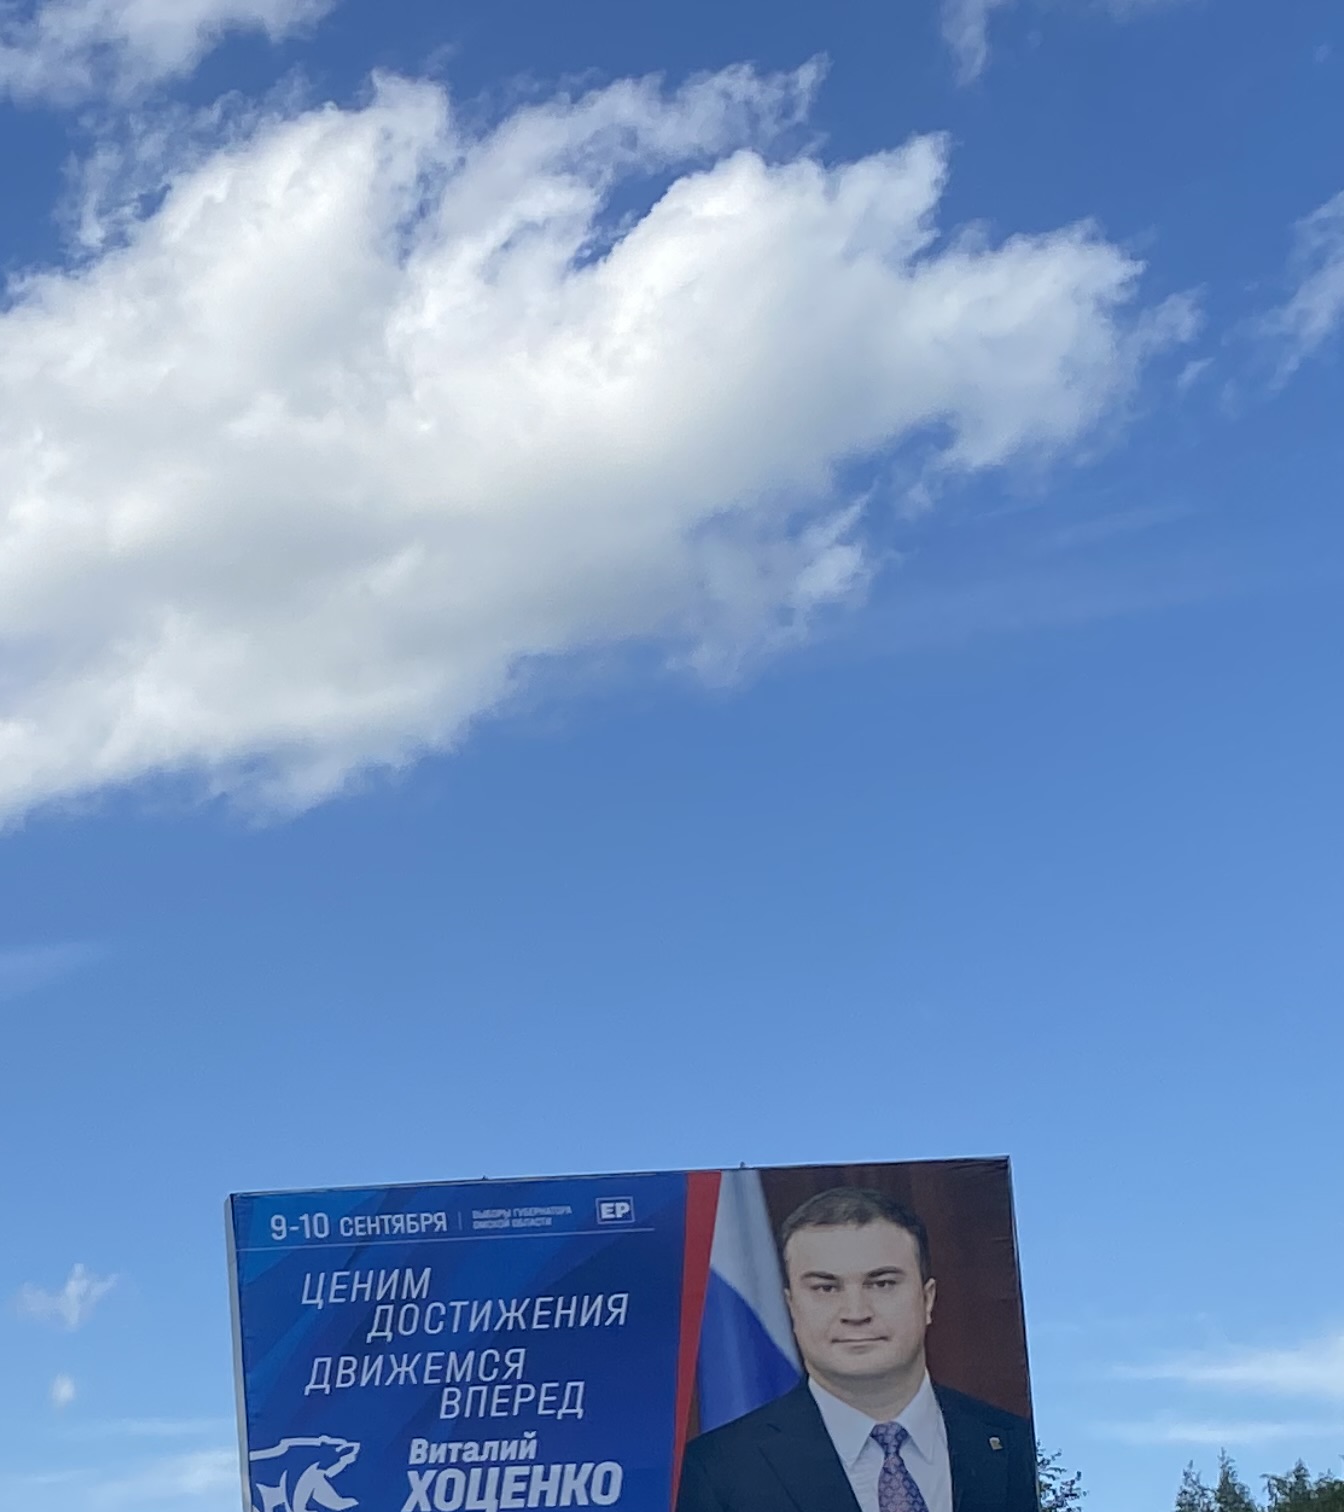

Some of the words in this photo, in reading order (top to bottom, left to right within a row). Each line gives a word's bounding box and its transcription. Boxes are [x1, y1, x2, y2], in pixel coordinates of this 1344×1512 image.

[270, 1211, 330, 1241] 9-10
[339, 1211, 448, 1237] СЕНТЯБРЯ
[301, 1267, 431, 1310] ЦЕНИМ
[366, 1292, 629, 1344] ДОСТИЖЕНИЯ
[304, 1348, 526, 1396] ДВИЖЕМСЯ
[439, 1380, 585, 1420] ВПЕРЕД
[408, 1430, 538, 1465] Виталий
